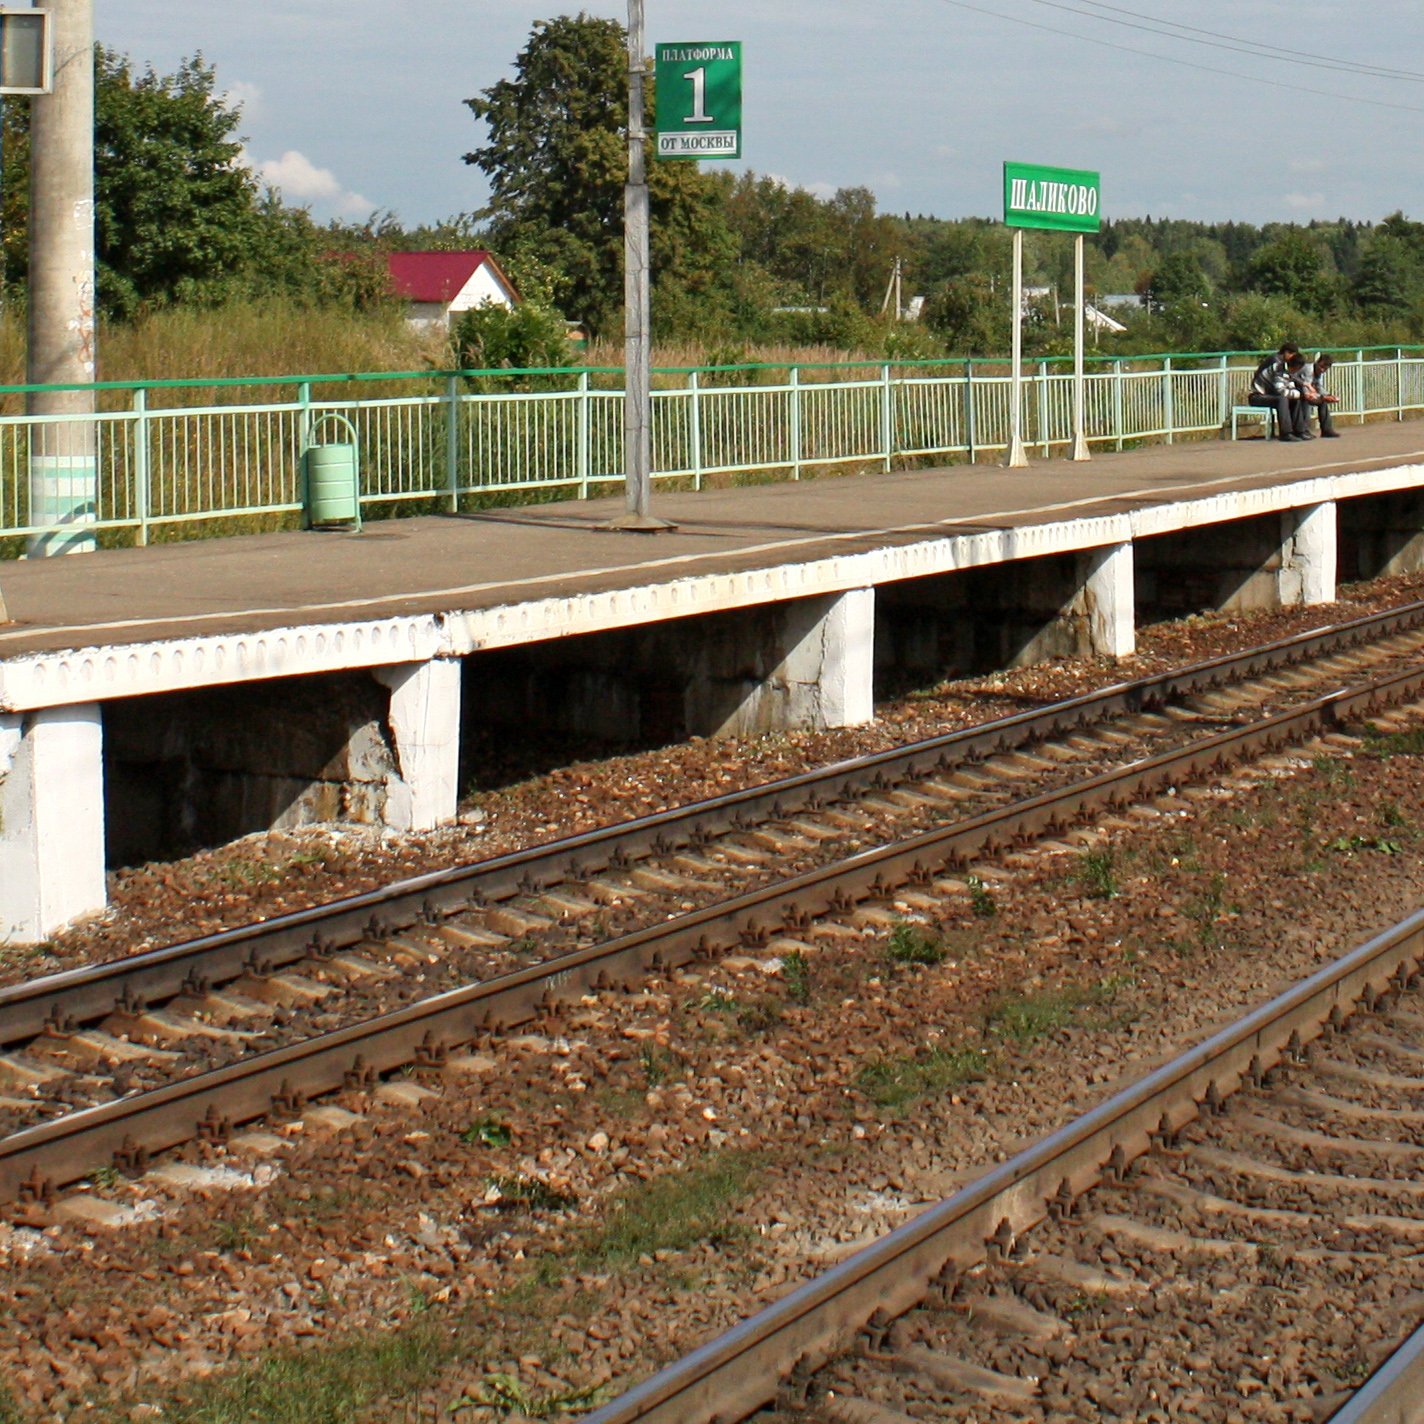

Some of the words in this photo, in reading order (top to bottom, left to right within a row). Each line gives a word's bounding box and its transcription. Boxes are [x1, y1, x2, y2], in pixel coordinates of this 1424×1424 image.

[662, 47, 734, 62] ПЛАТФОРМА
[683, 66, 714, 123] 1
[660, 137, 677, 150] ОТ
[681, 135, 735, 150] МОСКВЫ
[1010, 178, 1097, 216] ШАЛИКОВО
